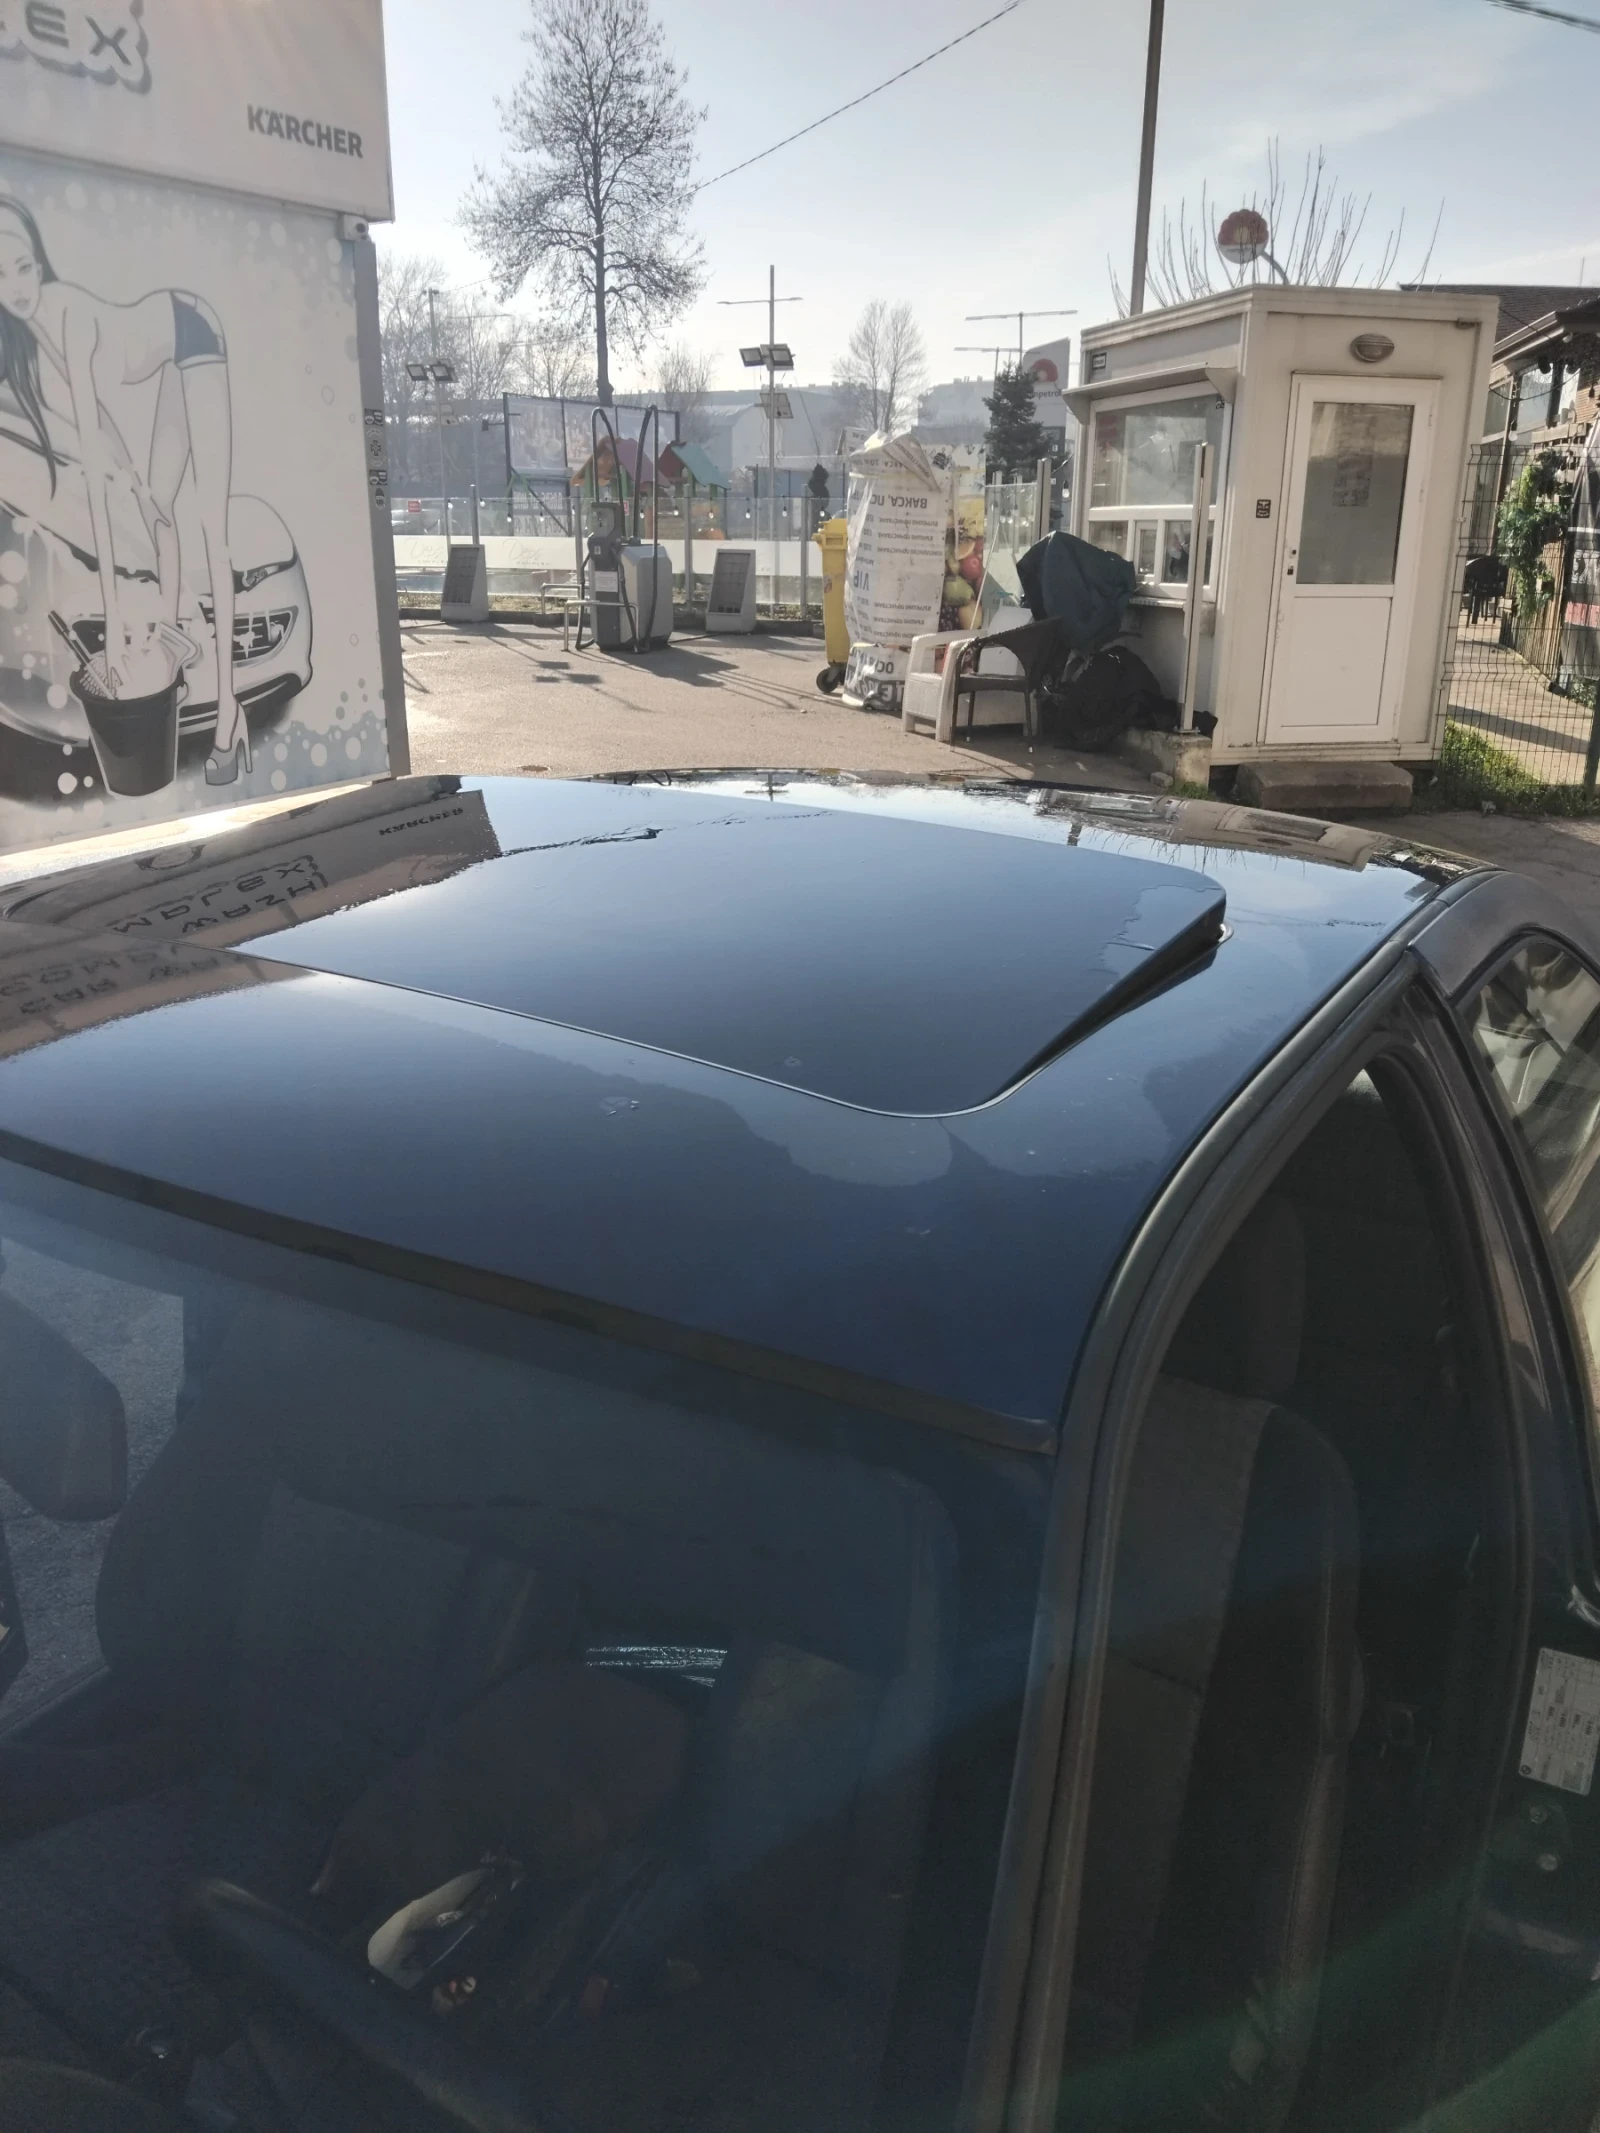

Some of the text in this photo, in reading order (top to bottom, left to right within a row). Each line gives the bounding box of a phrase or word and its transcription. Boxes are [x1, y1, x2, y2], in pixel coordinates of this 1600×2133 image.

[0, 1, 132, 66] EX
[246, 103, 364, 159] KÄRCHER
[887, 494, 928, 509] ВАКСА,
[853, 570, 870, 591] VIP
